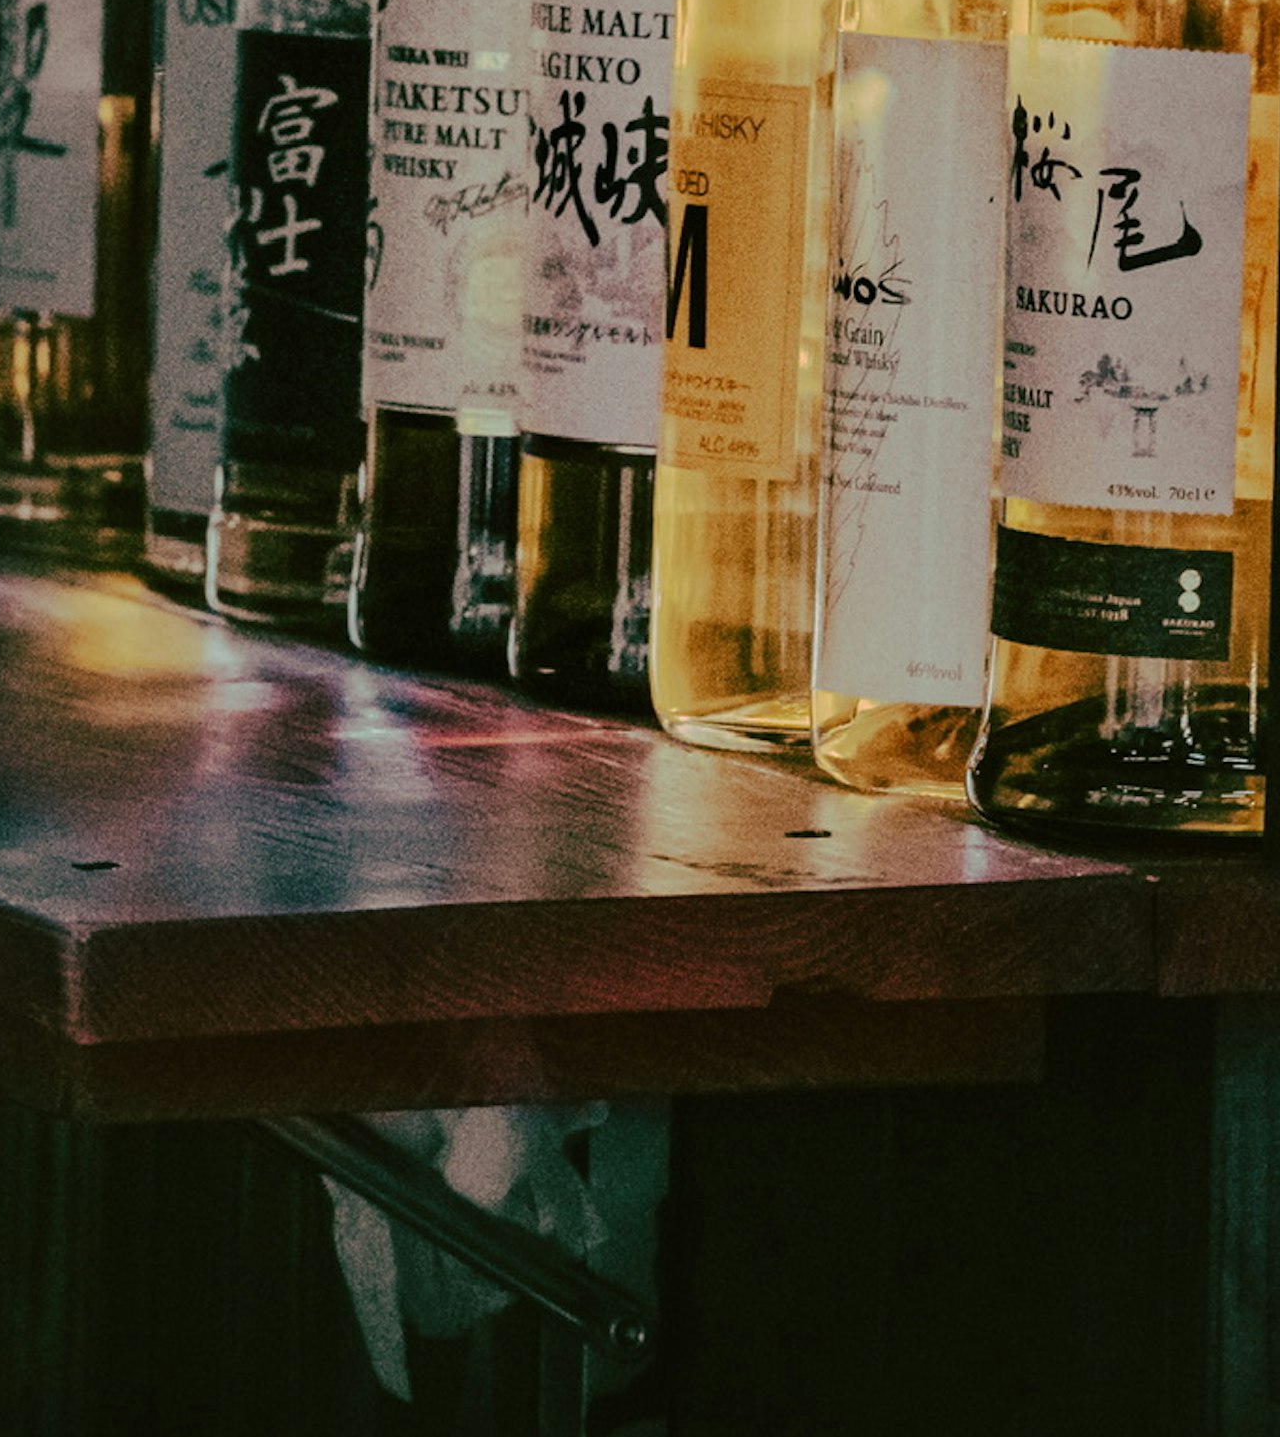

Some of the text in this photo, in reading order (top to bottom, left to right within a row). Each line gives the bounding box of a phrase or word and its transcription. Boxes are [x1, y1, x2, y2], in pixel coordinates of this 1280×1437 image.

[582, 8, 676, 40] MALT
[384, 118, 508, 151] PURE MALT
[257, 74, 339, 277] 富士
[382, 152, 458, 181] WHISKY
[1016, 285, 1133, 321] SAKURAO
[1169, 485, 1200, 501] 70cl
